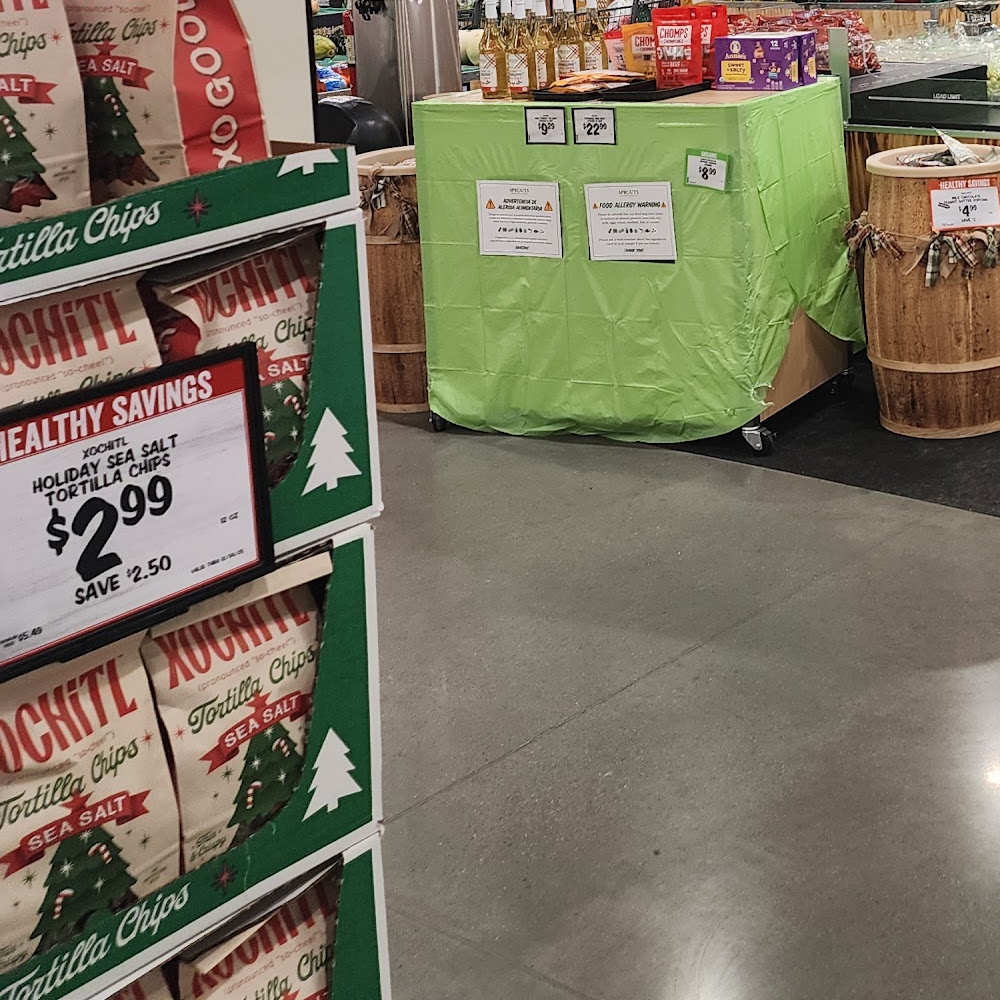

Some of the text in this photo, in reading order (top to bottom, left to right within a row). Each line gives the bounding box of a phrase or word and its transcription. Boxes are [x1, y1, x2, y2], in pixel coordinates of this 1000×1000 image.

[121, 19, 158, 44] Chips
[659, 28, 689, 39] CHOMPS
[0, 77, 33, 94] ALT
[102, 58, 137, 75] SALT
[614, 201, 636, 209] ALLERGY
[940, 178, 991, 189] HEALTHY SAVINGS
[84, 200, 162, 243] Chips
[267, 357, 310, 378] SALT
[112, 370, 213, 431] SAVINGS
[32, 434, 179, 494] HOLIDAY SEA SALT
[82, 436, 129, 460] XOCHITL
[44, 453, 171, 506] TORTILLA CHIPS
[75, 574, 121, 605] SAVE
[126, 555, 172, 583] $2.50
[188, 644, 315, 734] Tortilla Chips
[224, 696, 299, 748] SEA SALT
[0, 736, 139, 830] Tortilla Chips
[28, 794, 128, 852] SEA SALT
[0, 881, 192, 1000] Tortilla Chips
